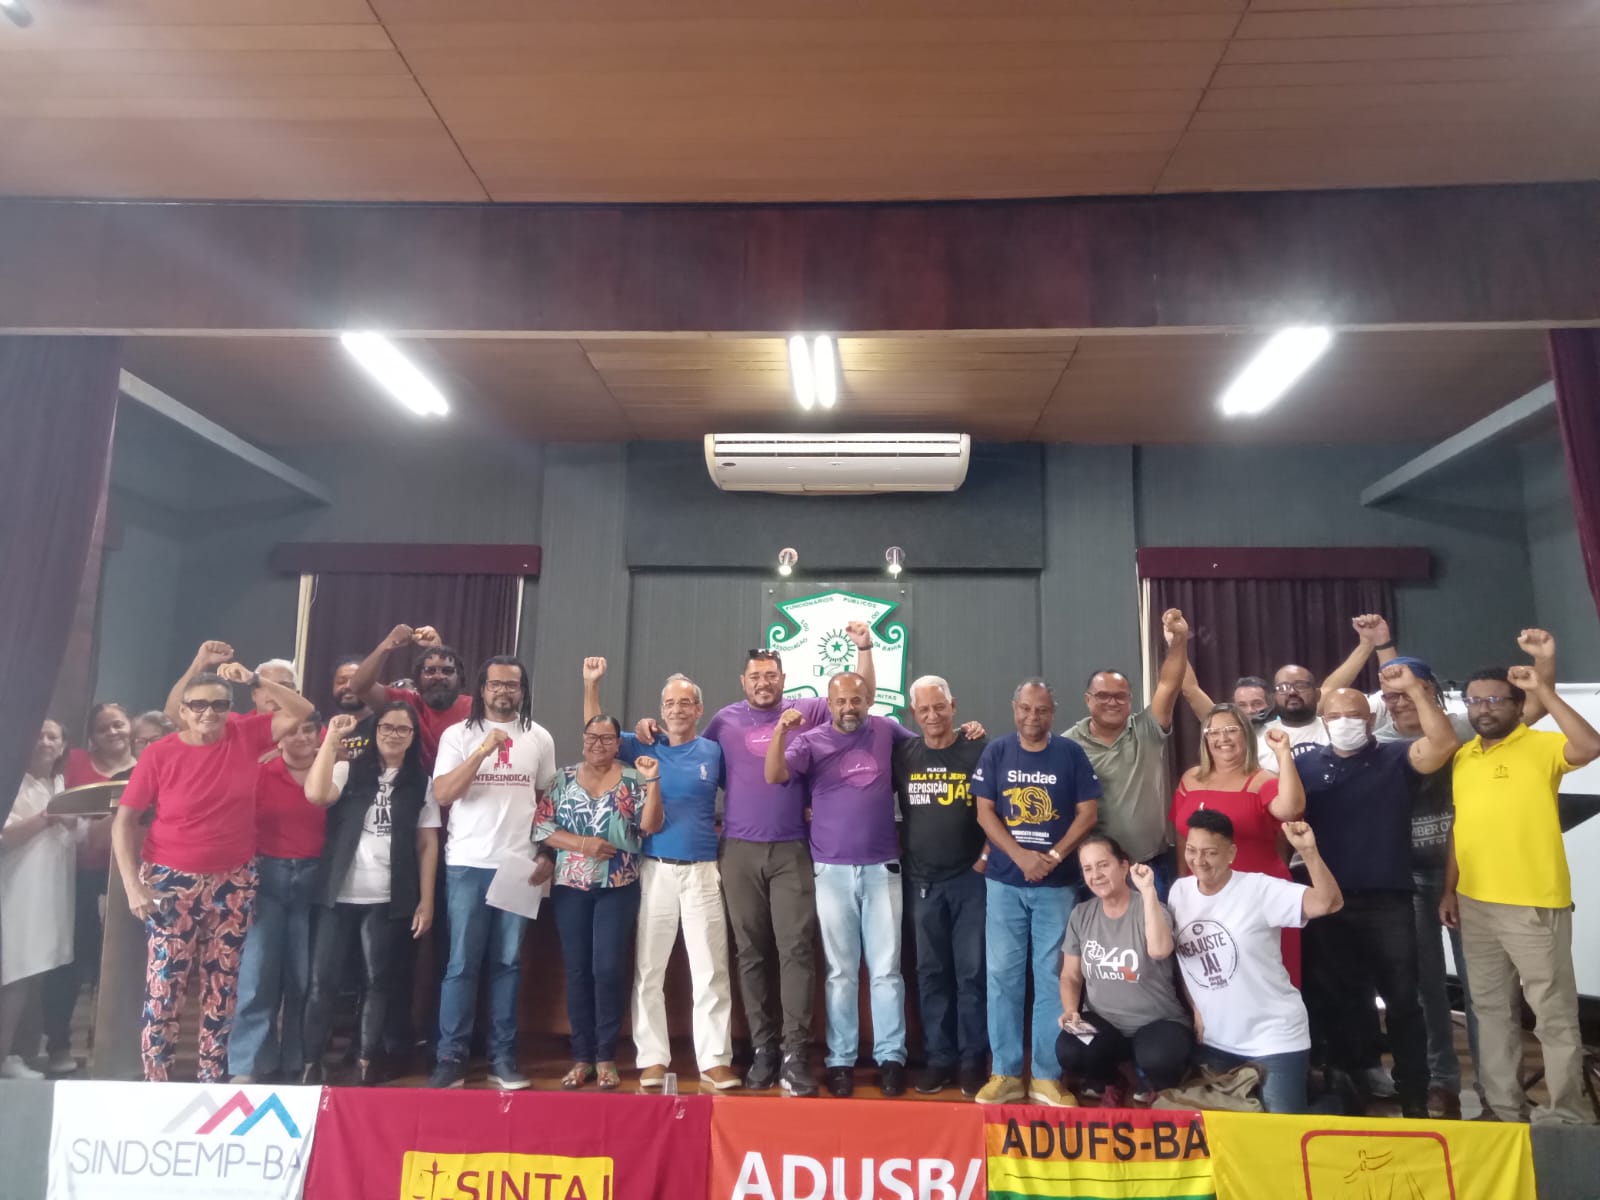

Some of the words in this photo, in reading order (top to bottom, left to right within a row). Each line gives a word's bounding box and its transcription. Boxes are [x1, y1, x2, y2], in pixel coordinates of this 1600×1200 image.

[910, 773, 927, 781] LULA
[1007, 770, 1057, 785] Sindae
[908, 781, 948, 796] REPOSIÇÃO
[937, 779, 973, 806] JÁ!
[909, 793, 931, 805] DIGNA
[1177, 931, 1228, 959] REAJUSTE
[1199, 952, 1223, 977] JÁ!
[1001, 1117, 1211, 1161] ADUFS-BA
[69, 1137, 302, 1181] SINDSEMP-BA
